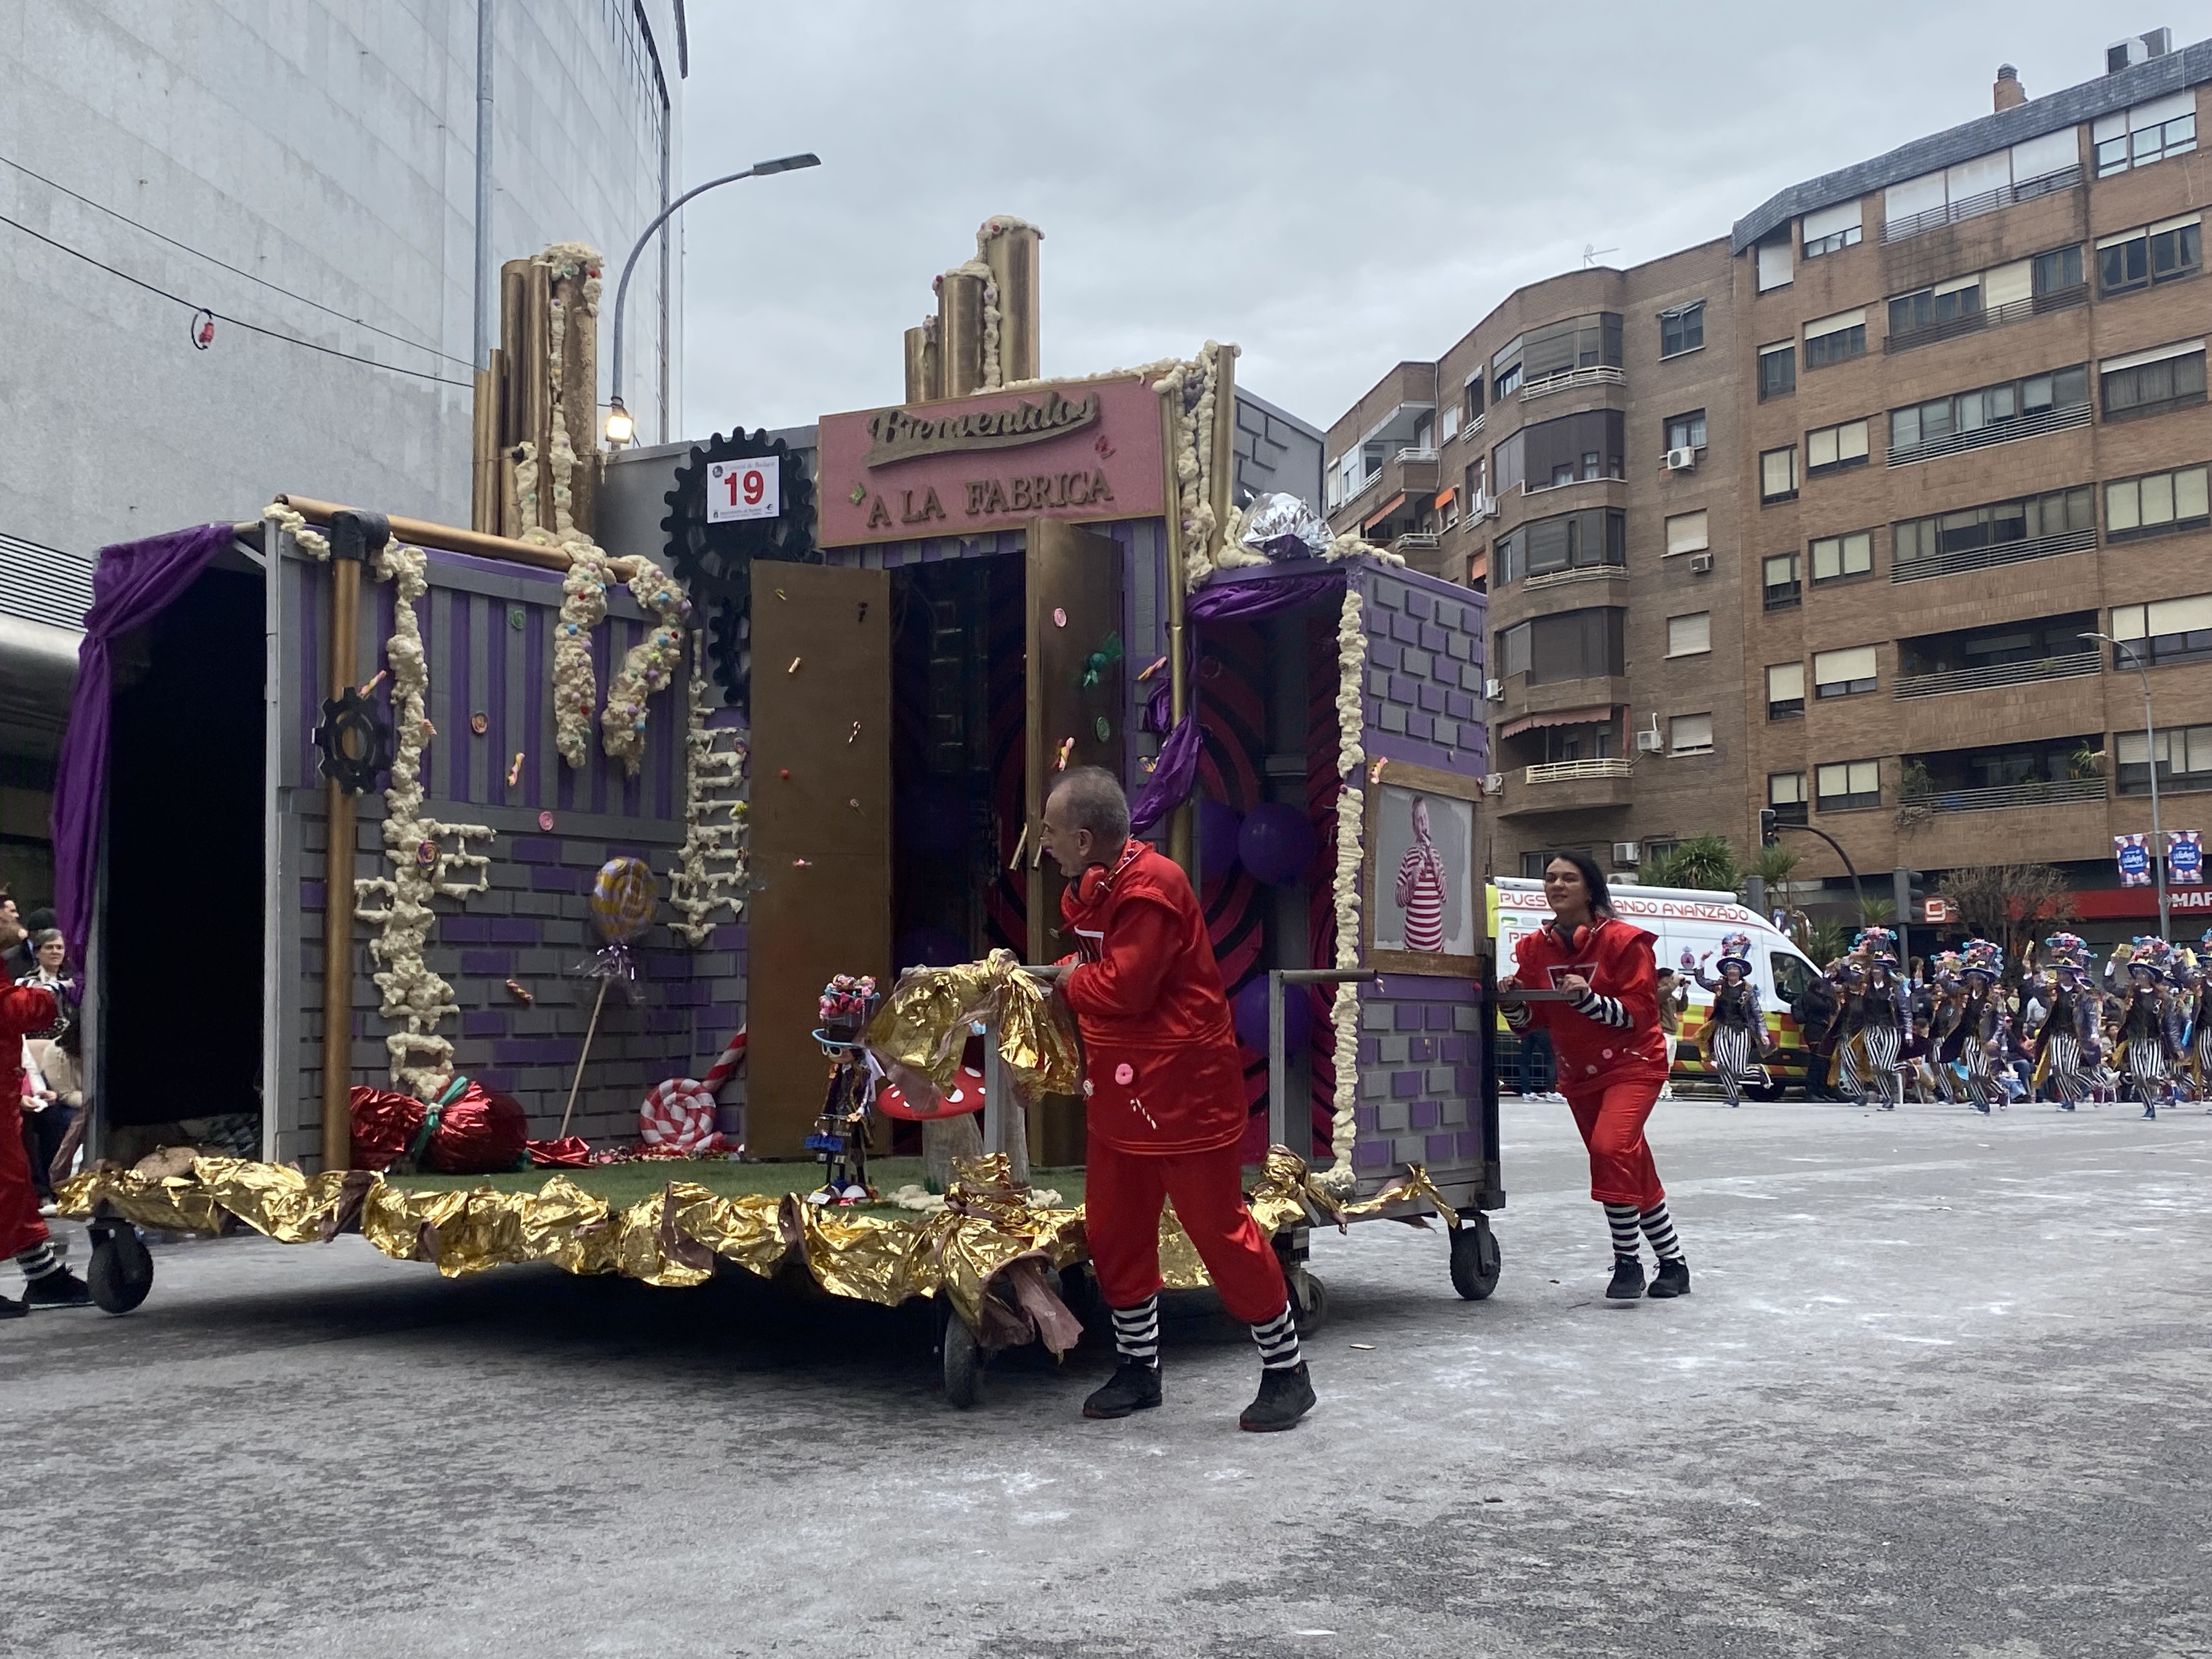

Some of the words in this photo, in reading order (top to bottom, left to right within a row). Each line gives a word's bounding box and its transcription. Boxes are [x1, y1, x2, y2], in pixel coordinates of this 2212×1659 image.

[867, 390, 1099, 443] Bienvenidos
[724, 470, 764, 506] 19
[866, 496, 892, 528] A
[901, 487, 946, 523] LA
[964, 468, 1114, 515] FABRICA
[1500, 893, 1547, 906] PUES
[1612, 900, 1657, 913] ANDO
[1662, 903, 1748, 921] AVANZADO
